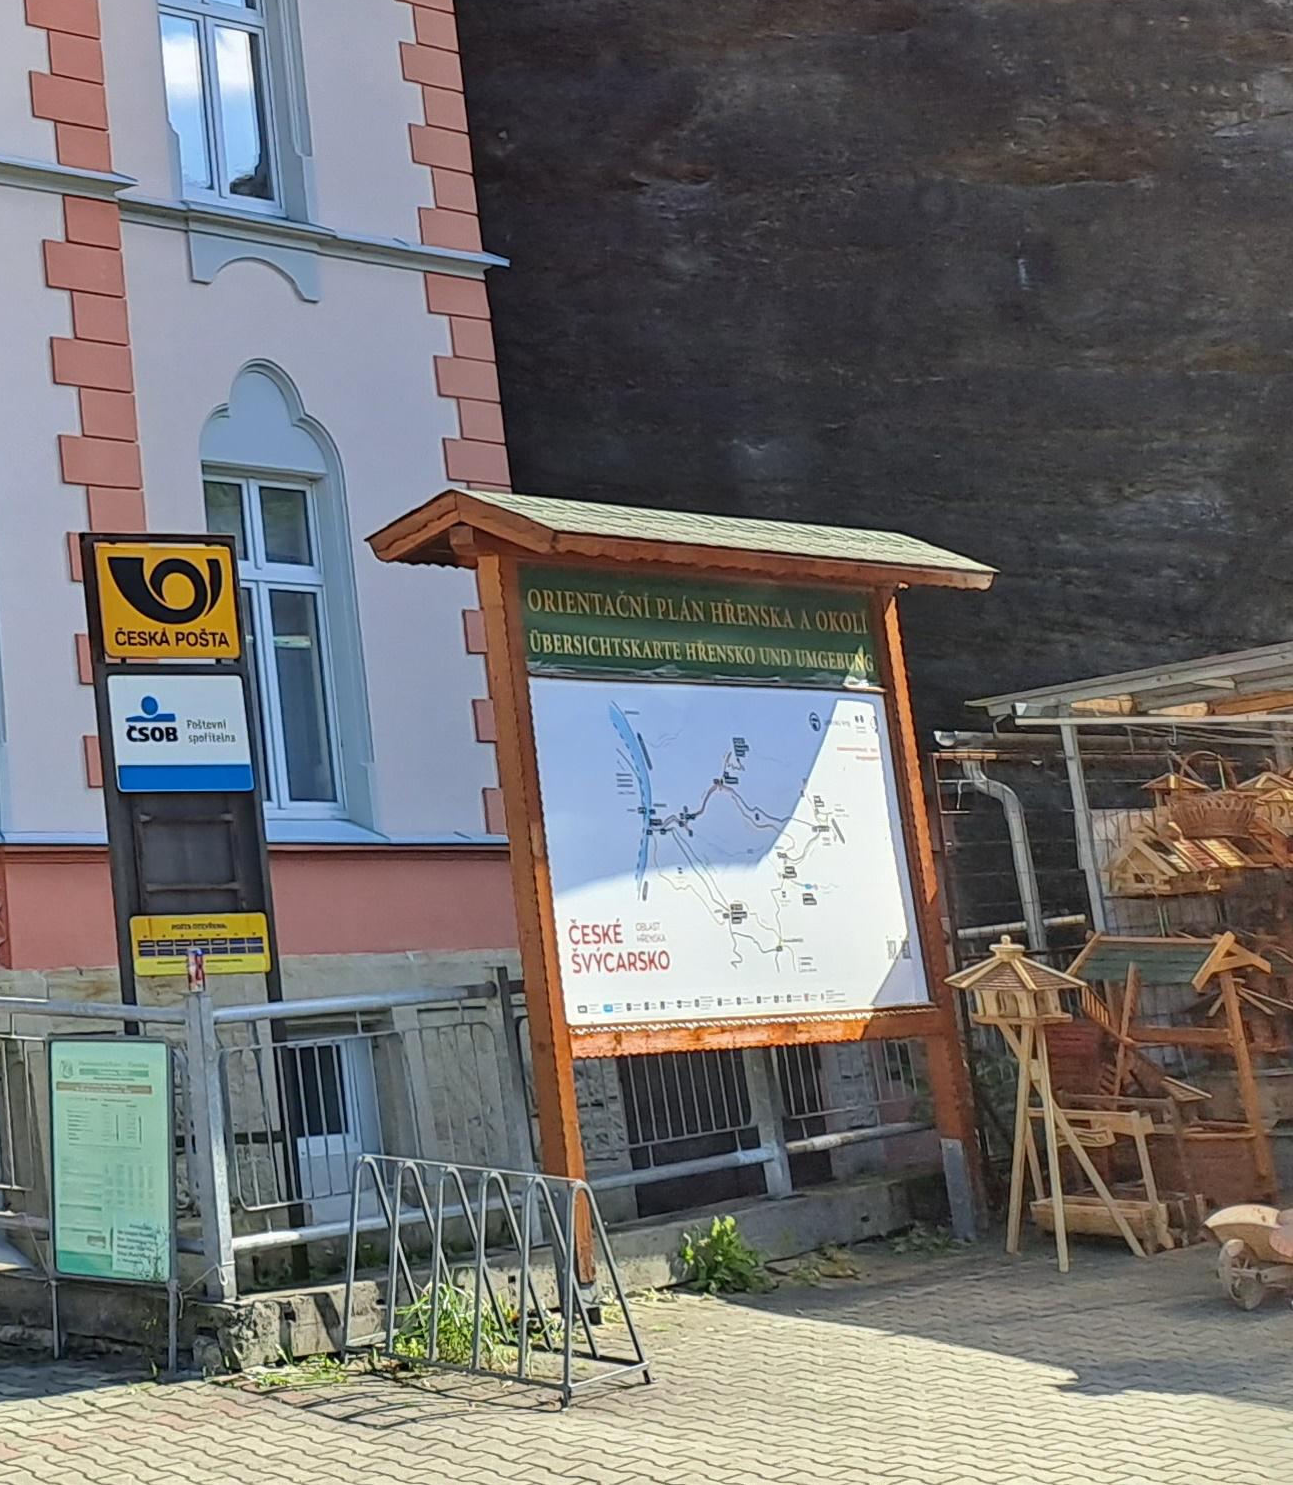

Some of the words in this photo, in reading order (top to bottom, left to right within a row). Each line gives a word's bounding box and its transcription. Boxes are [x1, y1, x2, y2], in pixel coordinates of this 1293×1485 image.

[527, 588, 651, 619] ORIENTAČNÍ
[656, 595, 705, 622] PLÁN
[709, 599, 797, 629] HŘENSKA
[800, 611, 812, 630] A
[815, 608, 869, 634] OKOLÍ
[114, 627, 171, 646] ČESKÁ
[174, 628, 230, 647] POŠTA
[529, 629, 682, 660] ÜBERSICHTSKARTE
[685, 640, 756, 664] HŘENSKO
[759, 647, 792, 666] UND
[794, 649, 874, 672] UMGEBUNG
[126, 725, 179, 742] ČSOB
[186, 719, 226, 730] Poštovní
[188, 734, 236, 745] spořitelna
[568, 918, 624, 945] ČESKÉ
[571, 947, 671, 974] ŠVÝCARSKO
